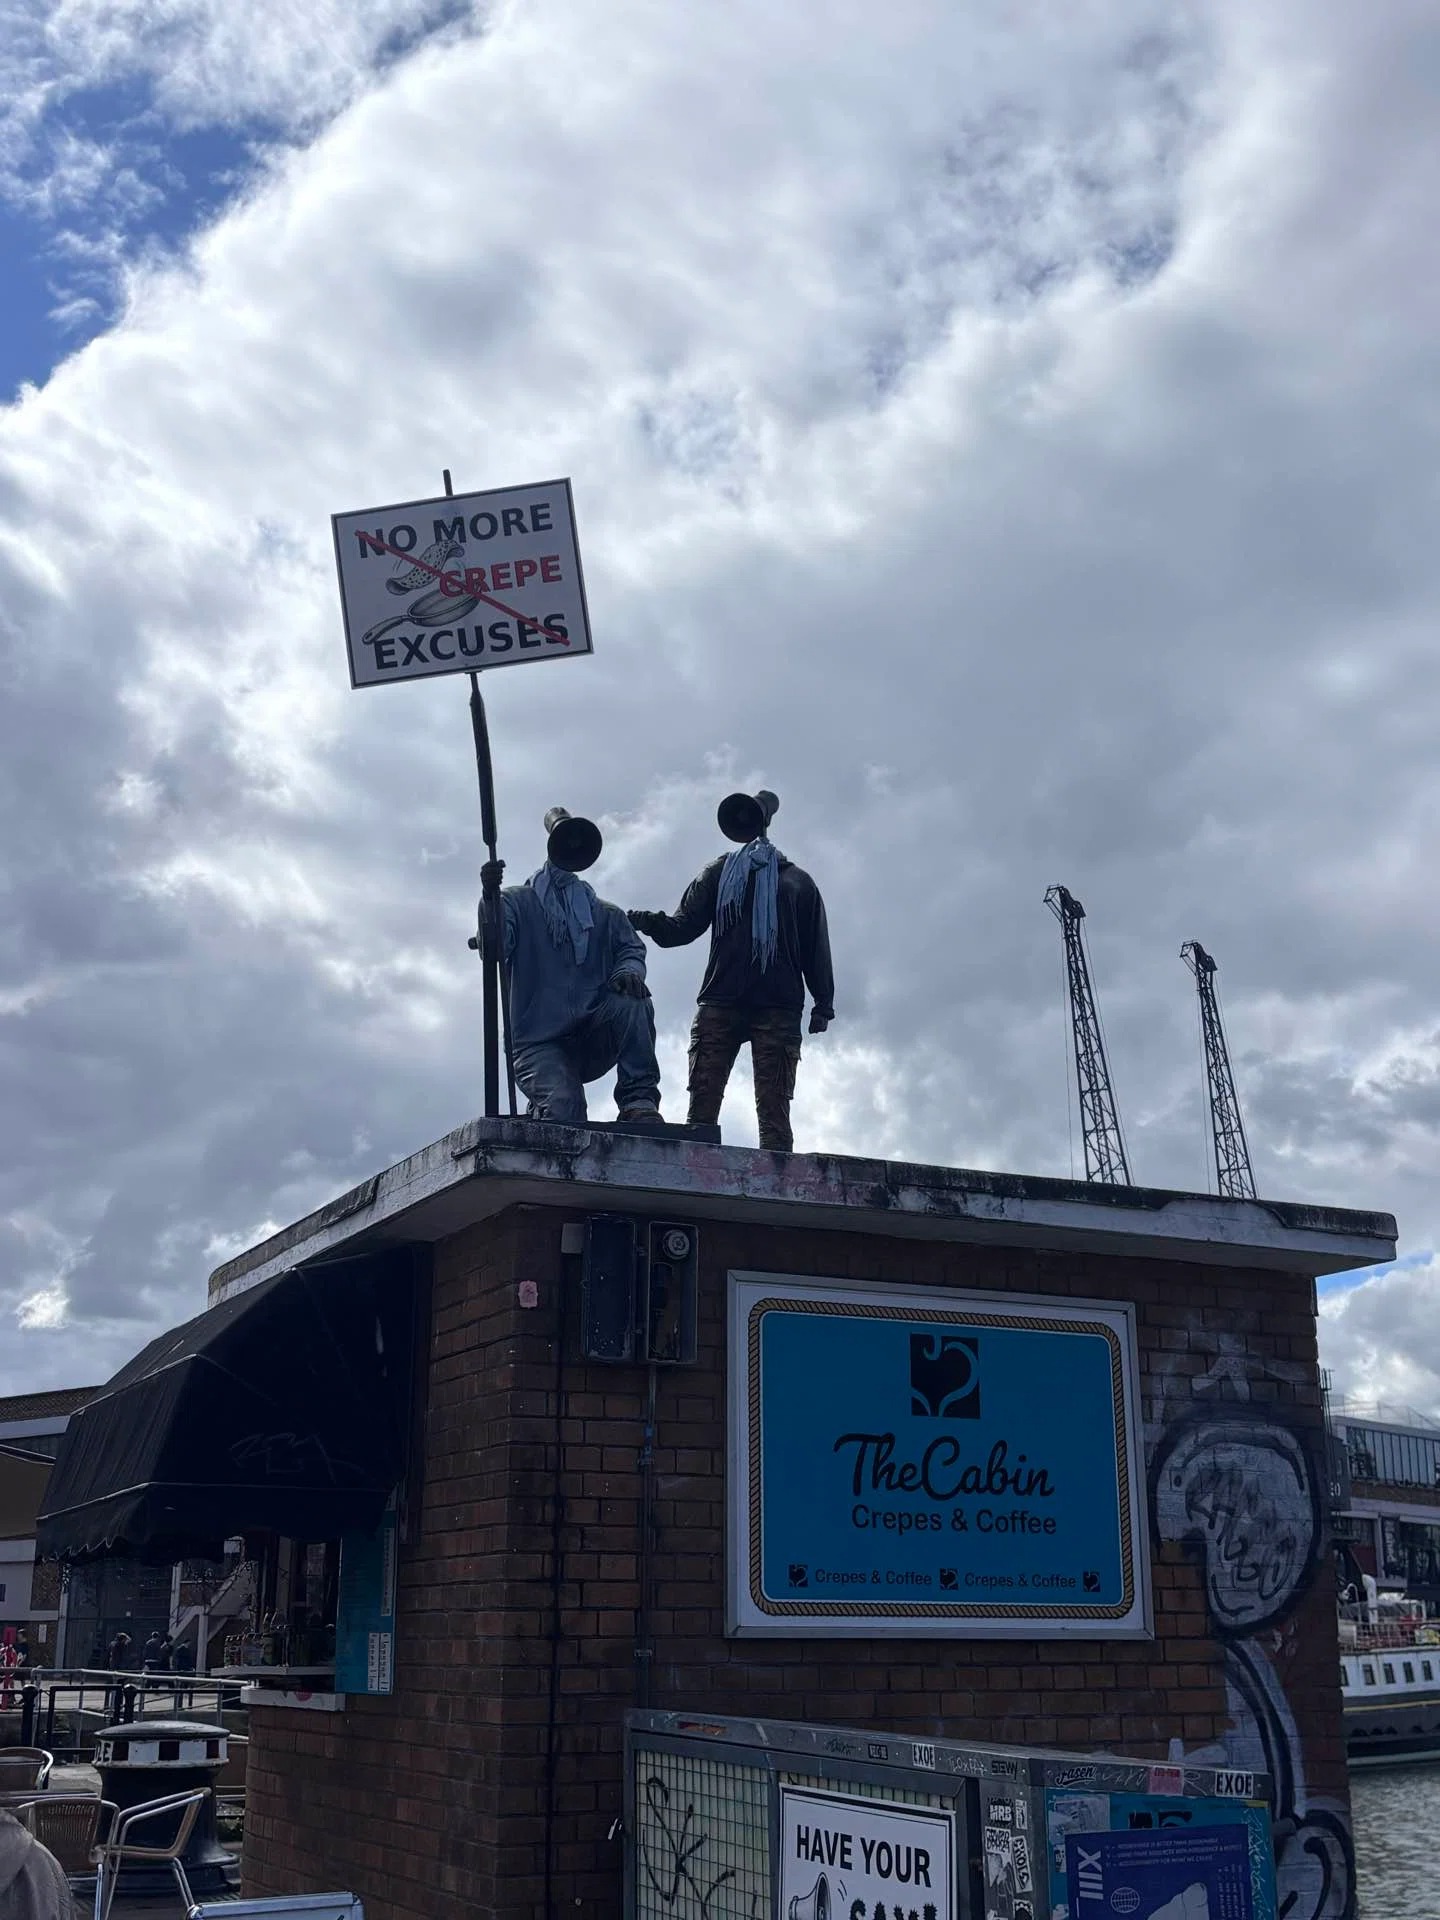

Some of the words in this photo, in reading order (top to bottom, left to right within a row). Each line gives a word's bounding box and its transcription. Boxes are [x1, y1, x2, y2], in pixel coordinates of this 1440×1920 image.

[357, 525, 418, 558] NO
[433, 503, 553, 544] MORE
[439, 555, 562, 598] CREPE
[373, 613, 569, 670] EXCUSES
[851, 1504, 942, 1536] Crepes
[951, 1509, 969, 1533] &
[976, 1509, 1057, 1535] Coffee
[815, 1568, 868, 1585] Crepes
[871, 1570, 881, 1584] &
[885, 1570, 932, 1586] Coffee
[964, 1572, 1014, 1588] Crepes
[1018, 1573, 1028, 1587] &
[1031, 1573, 1076, 1589] Coffee
[1216, 1772, 1253, 1795] EXOE
[797, 1824, 853, 1870] HAVE
[860, 1837, 931, 1888] YOUR
